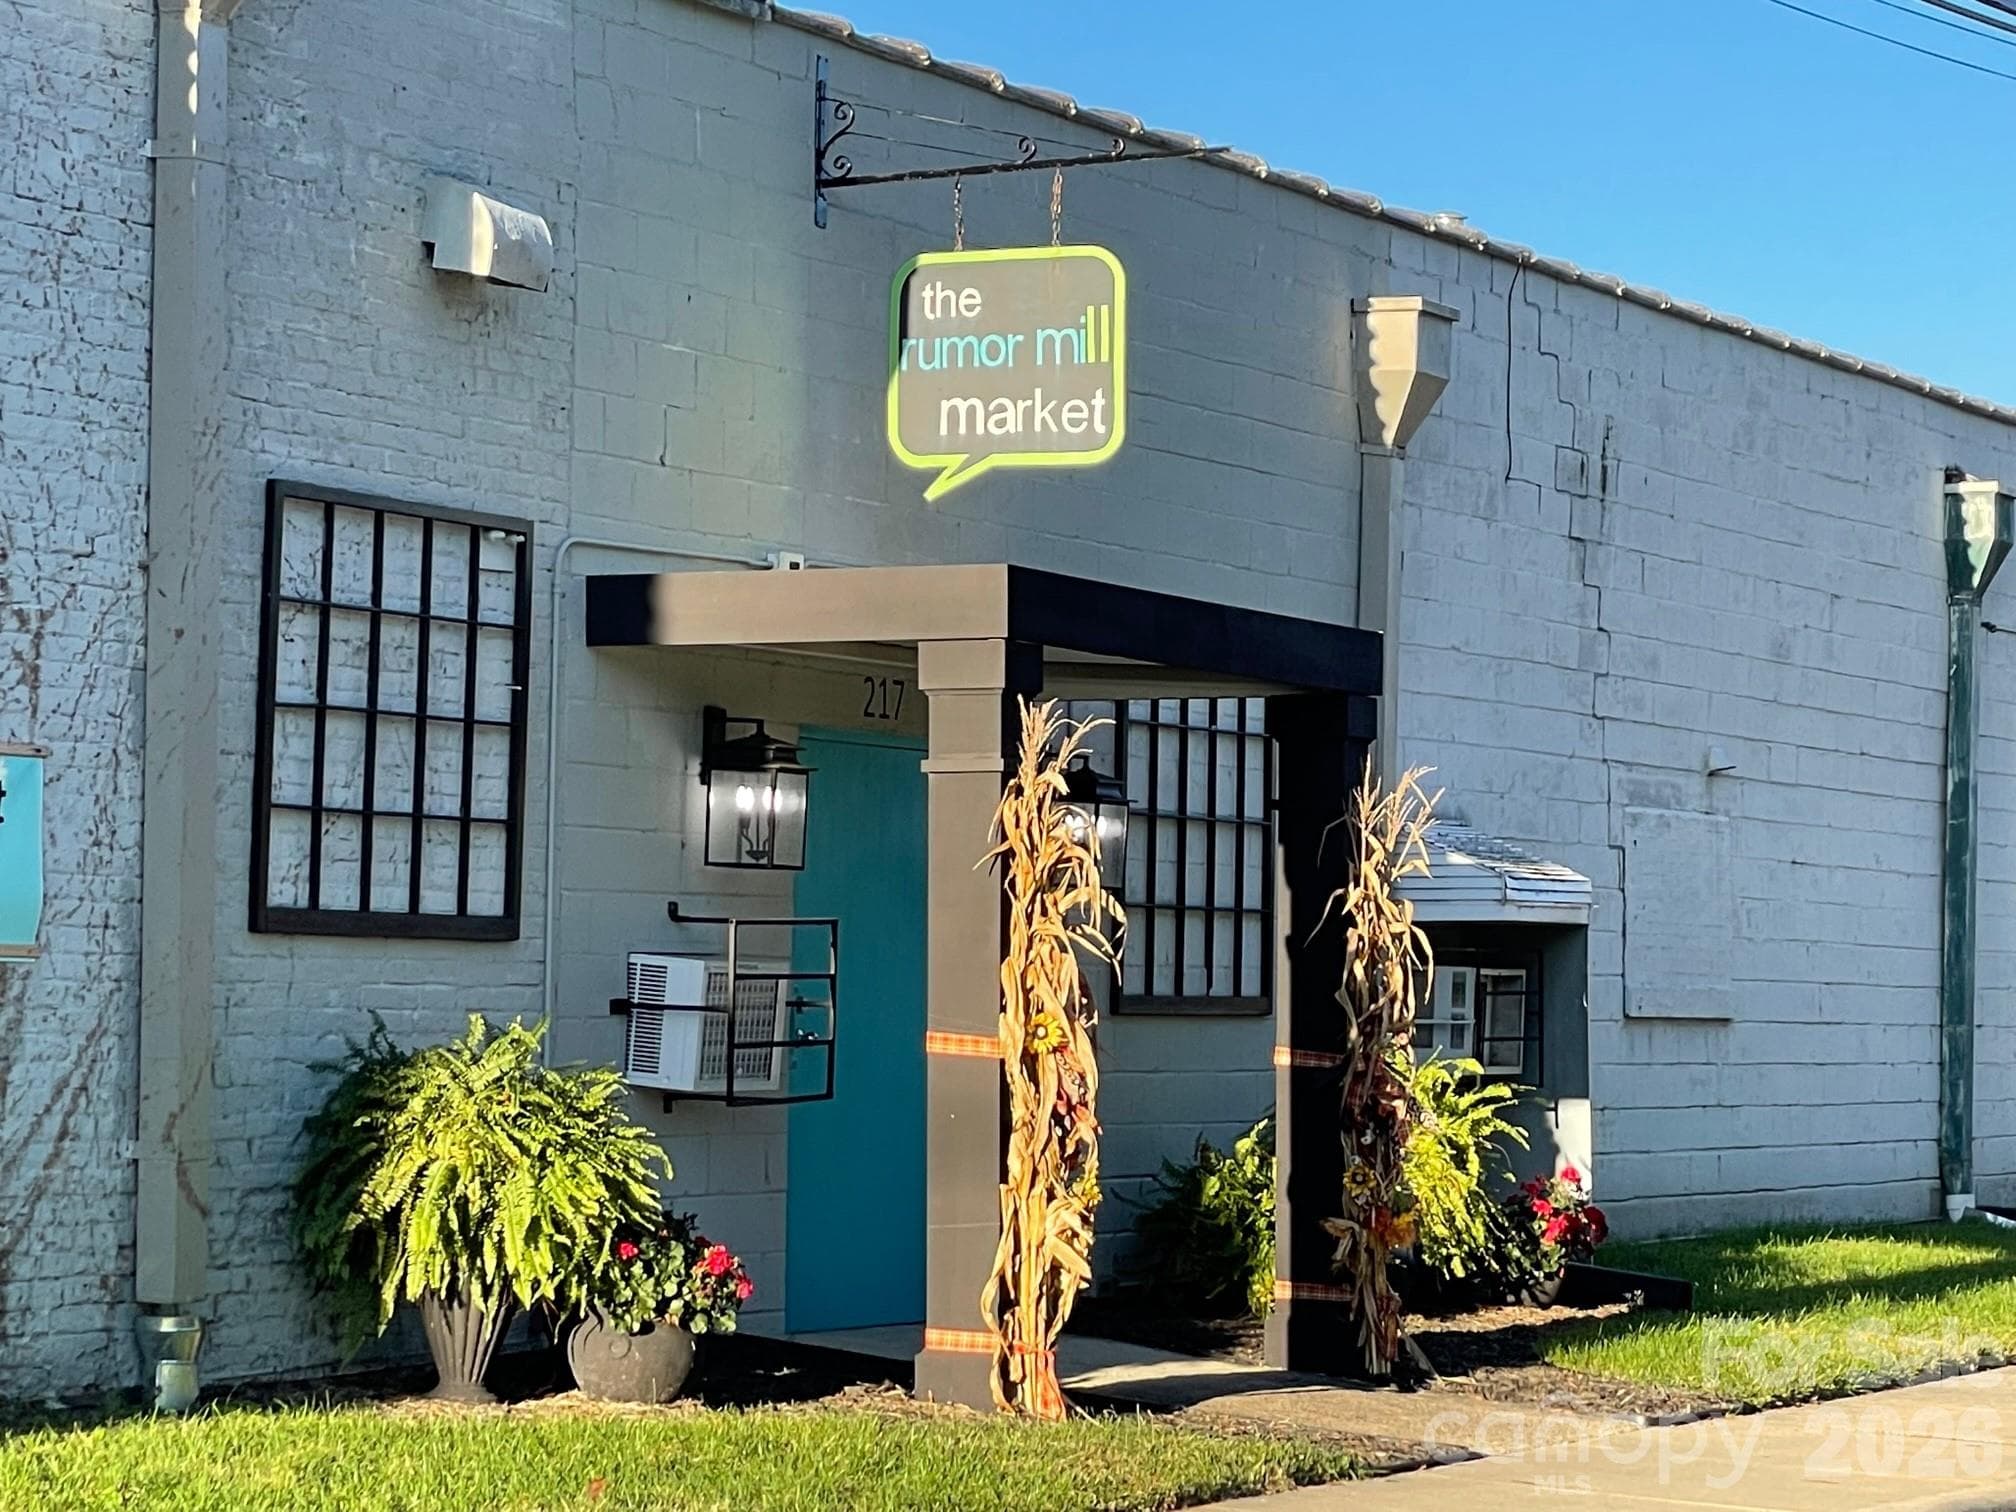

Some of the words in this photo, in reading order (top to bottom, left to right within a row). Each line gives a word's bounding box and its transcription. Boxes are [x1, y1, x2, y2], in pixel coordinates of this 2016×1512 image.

[921, 281, 982, 320] the
[901, 333, 1024, 371] rumor
[1036, 304, 1110, 366] mill
[939, 387, 1106, 435] market
[864, 676, 905, 720] 217
